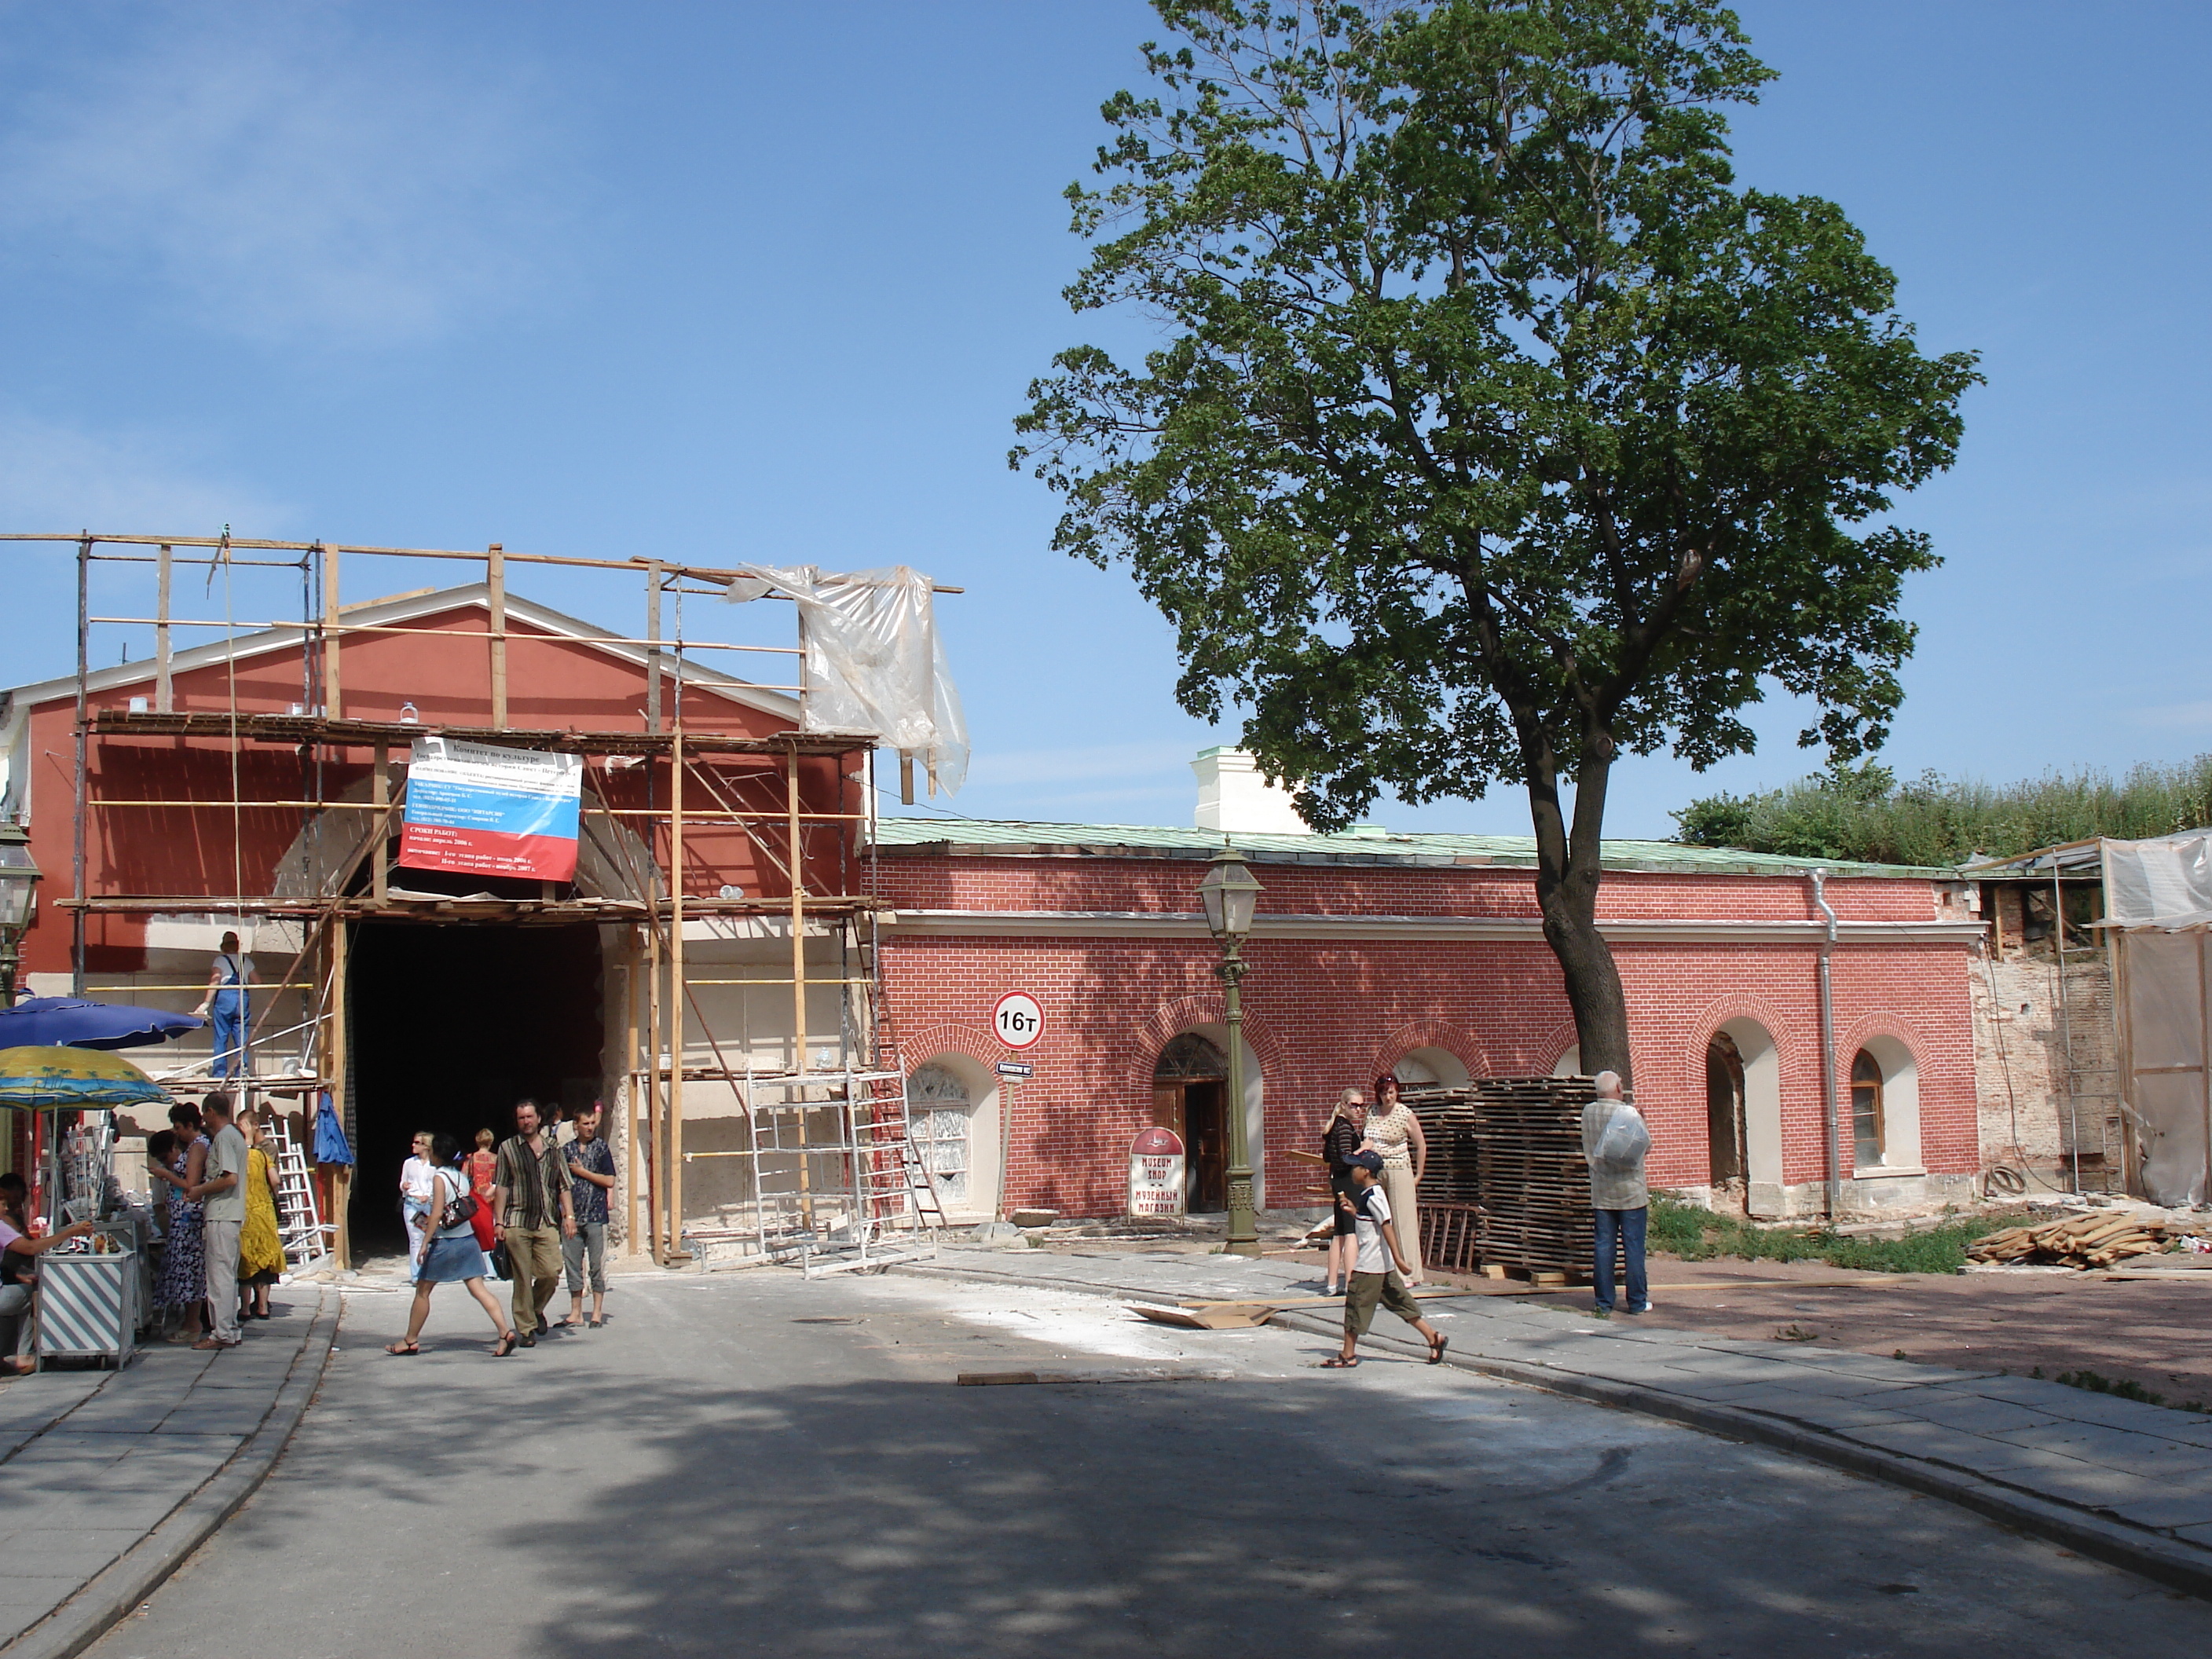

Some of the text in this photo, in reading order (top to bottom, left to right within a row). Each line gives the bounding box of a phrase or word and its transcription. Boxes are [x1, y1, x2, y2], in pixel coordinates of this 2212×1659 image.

[453, 745, 488, 756] Комитет
[502, 753, 540, 763] культуре
[434, 828, 458, 837] РАБОТ:
[1142, 1158, 1172, 1168] MUSEUM
[1148, 1170, 1166, 1180] SHOP
[1135, 1189, 1177, 1201] МУЗЕЙНЫЙ
[1138, 1203, 1174, 1214] МАГАЗИН
